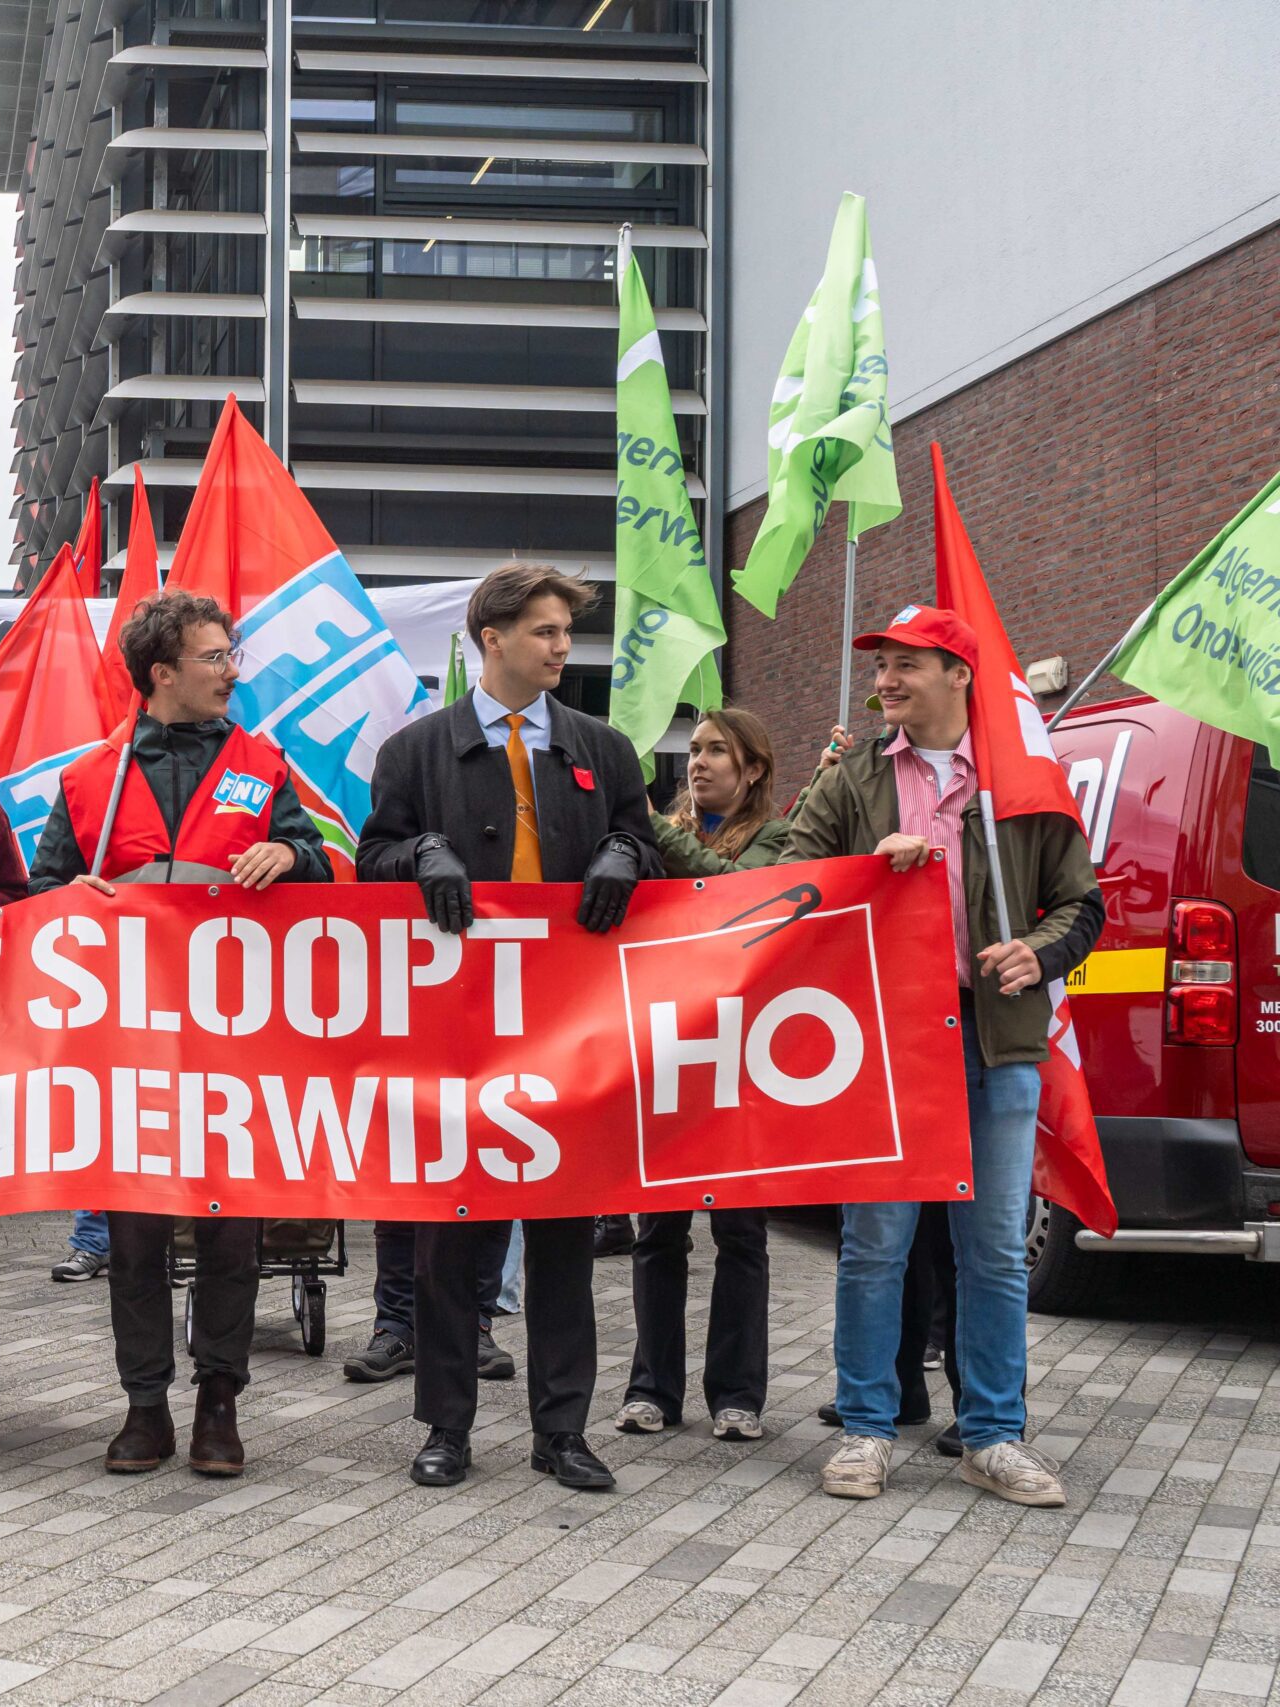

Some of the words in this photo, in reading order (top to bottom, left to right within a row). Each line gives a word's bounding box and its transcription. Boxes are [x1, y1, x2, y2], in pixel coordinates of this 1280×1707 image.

[218, 776, 270, 805] FNV
[28, 915, 549, 1038] SLOOPT
[649, 986, 864, 1115] HO
